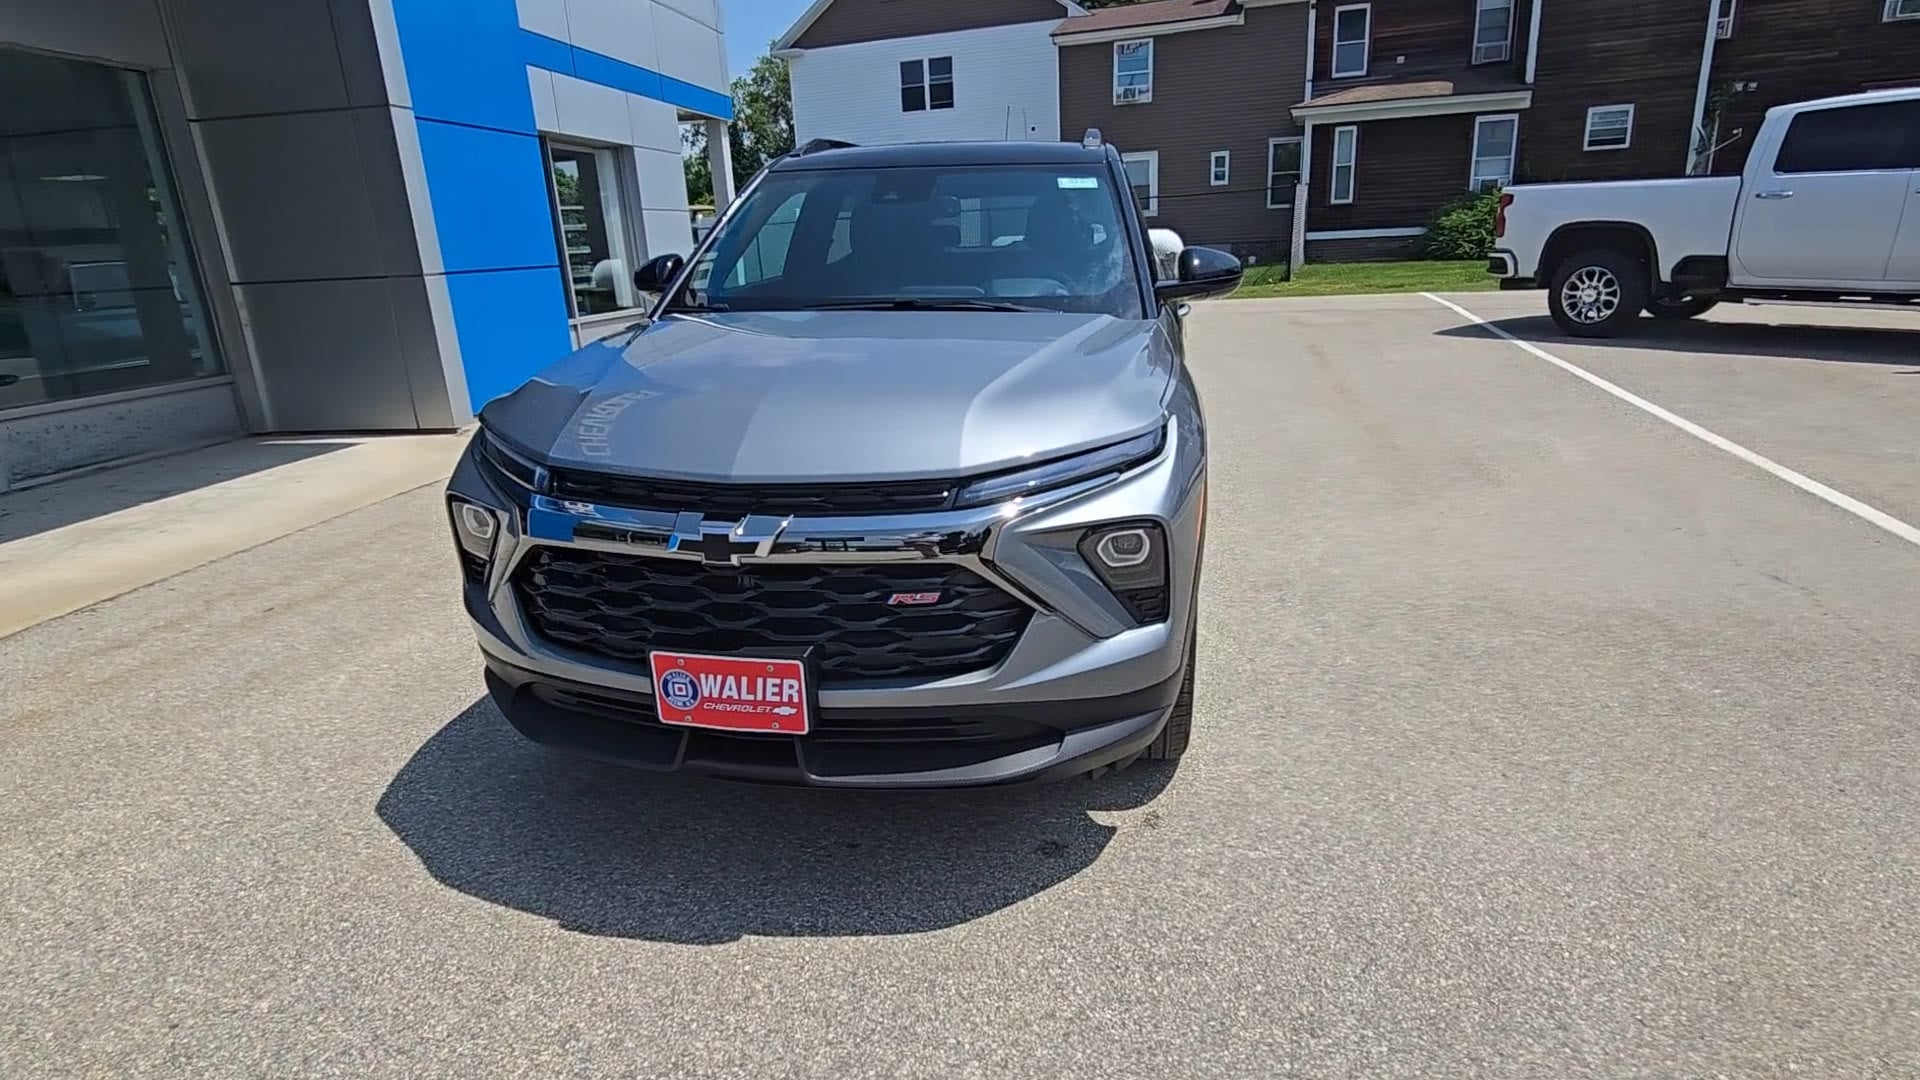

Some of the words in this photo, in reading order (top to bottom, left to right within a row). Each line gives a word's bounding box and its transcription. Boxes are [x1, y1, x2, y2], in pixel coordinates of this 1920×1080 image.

[887, 592, 941, 604] RS
[699, 673, 799, 703] WALIER
[703, 702, 772, 714] CHEVROLET
